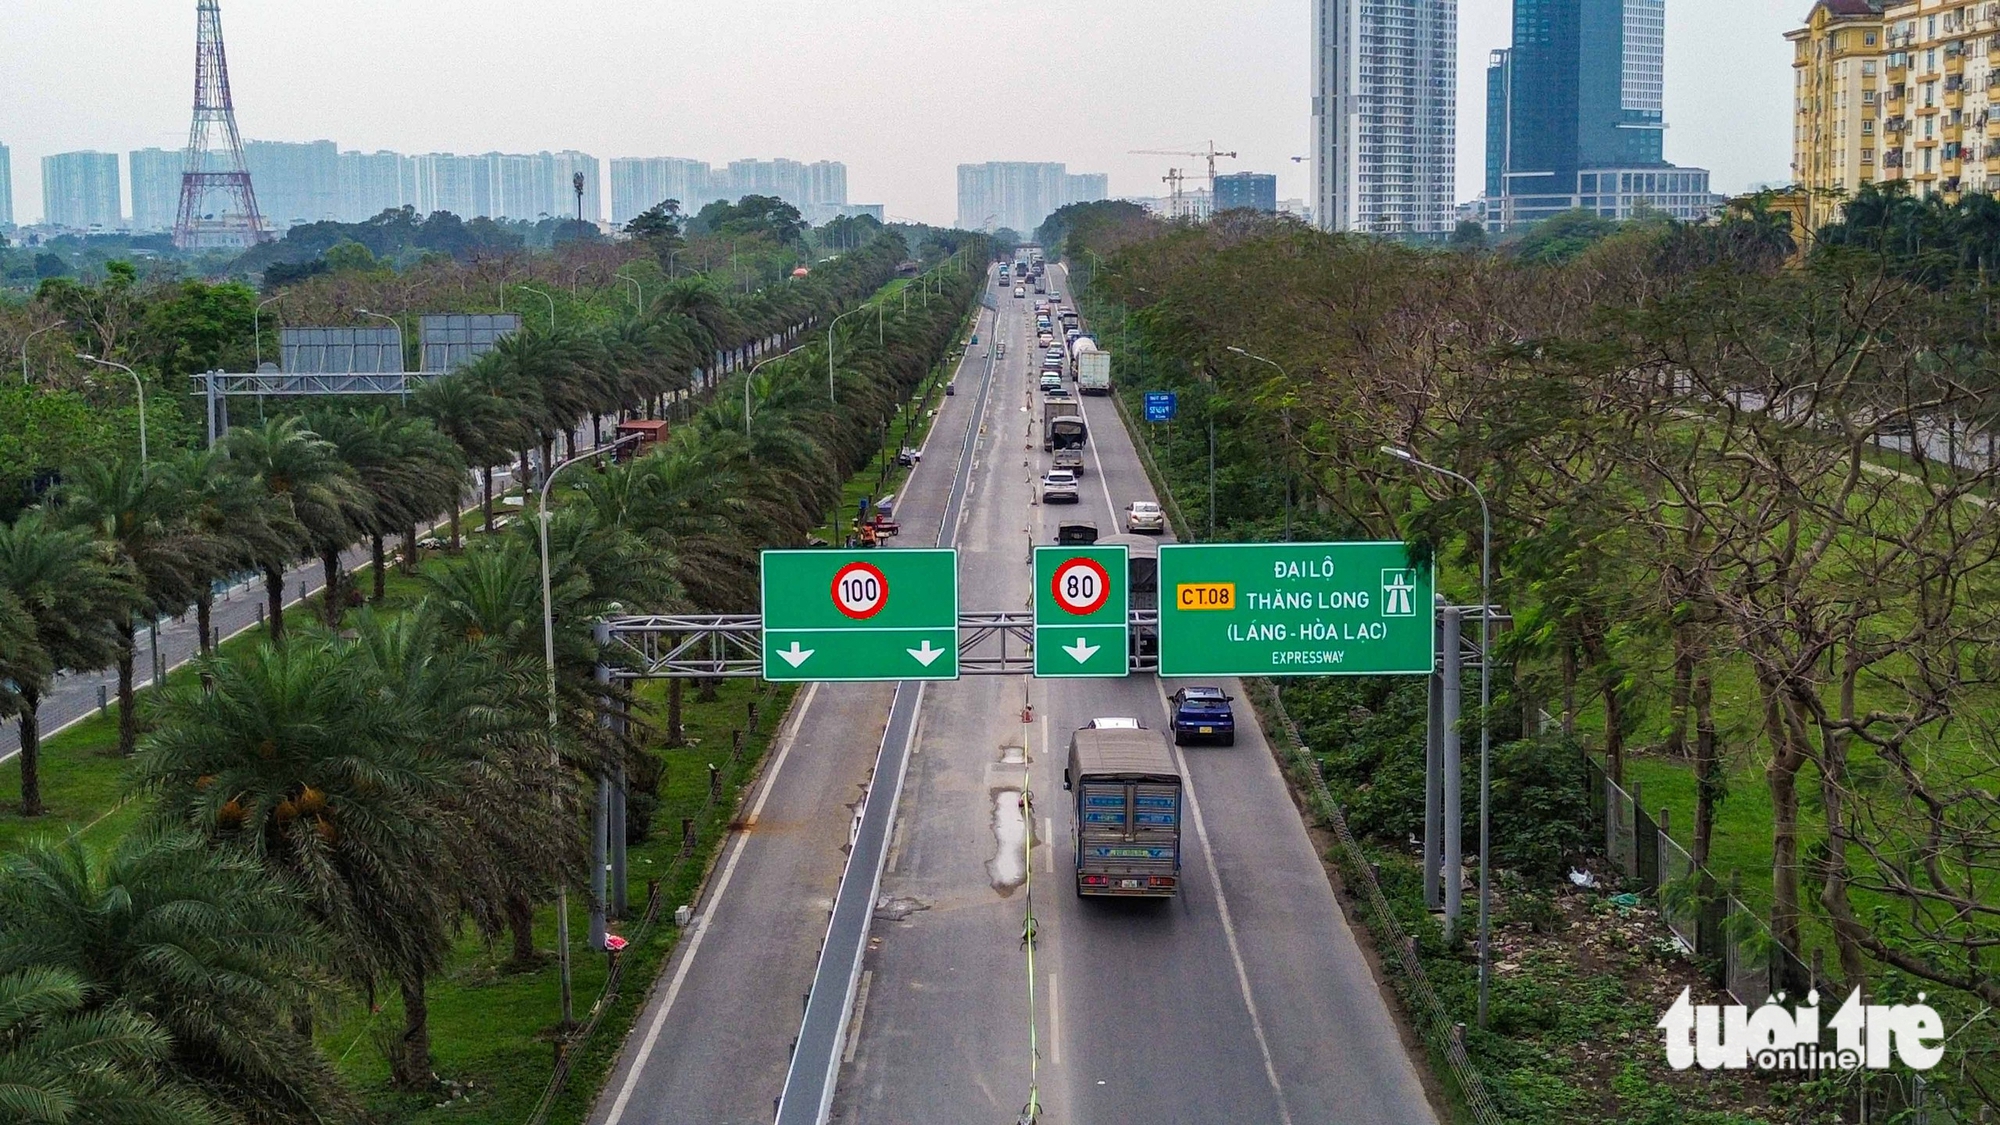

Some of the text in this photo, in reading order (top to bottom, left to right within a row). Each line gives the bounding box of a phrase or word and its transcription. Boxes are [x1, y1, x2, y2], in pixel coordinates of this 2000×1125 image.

[1274, 555, 1334, 582] ĐẠI LỘ
[842, 578, 877, 603] 100
[1067, 575, 1094, 599] 80
[1182, 588, 1230, 605] CT.08
[1247, 588, 1369, 609] THĂNG LONG
[1227, 619, 1287, 642] (LÁNG
[1300, 618, 1338, 640] HÒA
[1344, 622, 1387, 643] LẠC)
[1272, 651, 1344, 664] EXPRESSWAY
